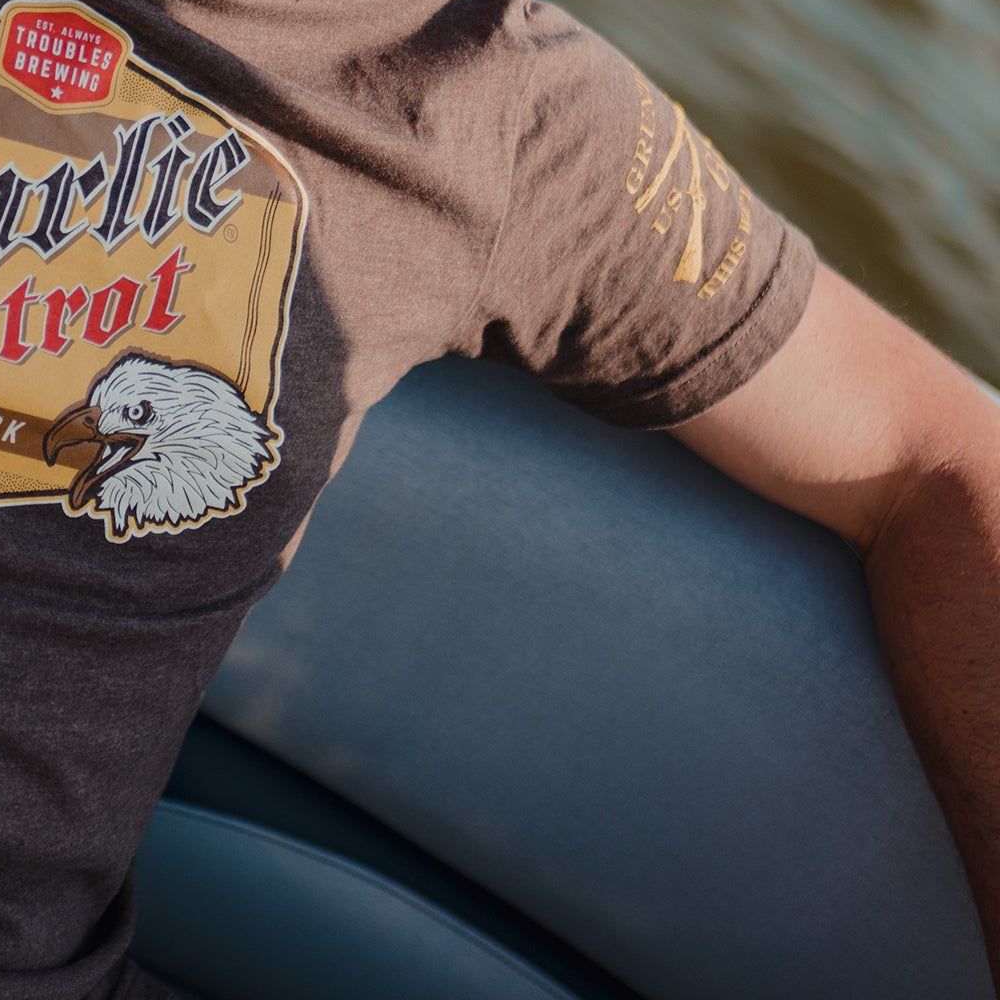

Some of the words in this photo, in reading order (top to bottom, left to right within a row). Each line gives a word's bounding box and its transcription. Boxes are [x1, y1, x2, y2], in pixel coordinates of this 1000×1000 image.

[16, 25, 113, 70] TROUBLES
[36, 19, 56, 34] EST.
[61, 27, 101, 45] ALWAYS
[14, 51, 100, 92] BREWING
[651, 187, 683, 235] US
[697, 237, 747, 299] THIS
